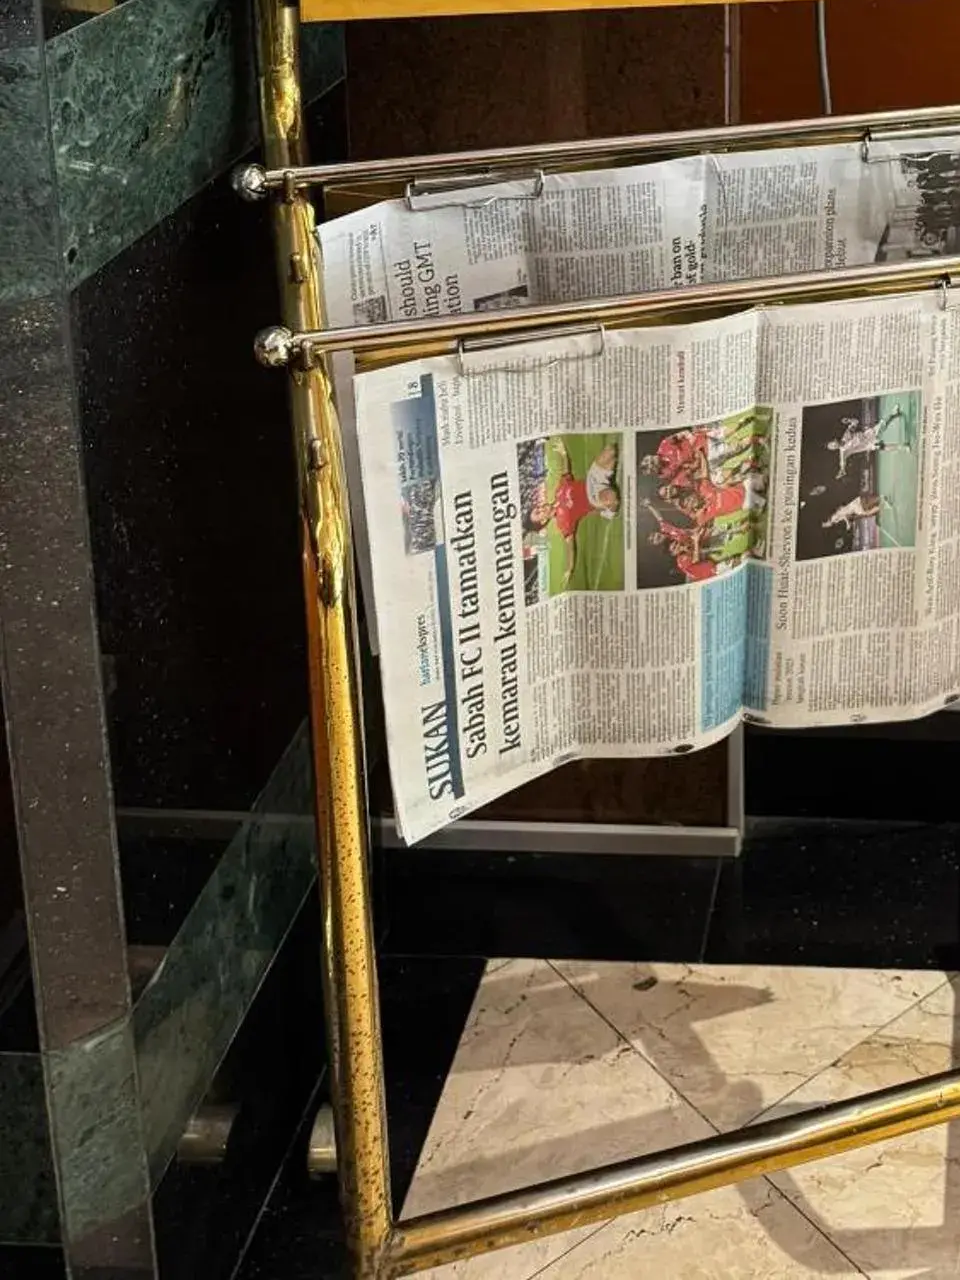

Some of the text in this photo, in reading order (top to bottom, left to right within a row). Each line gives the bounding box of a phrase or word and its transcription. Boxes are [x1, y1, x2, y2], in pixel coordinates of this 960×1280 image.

[414, 242, 435, 282] GMT
[670, 236, 682, 281] ban on
[393, 260, 417, 317] should
[780, 509, 793, 523] ke
[450, 490, 487, 759] Sabah FC II tamatkan
[489, 470, 521, 755] kemarau kemenangan
[421, 701, 454, 800] SUKAN
